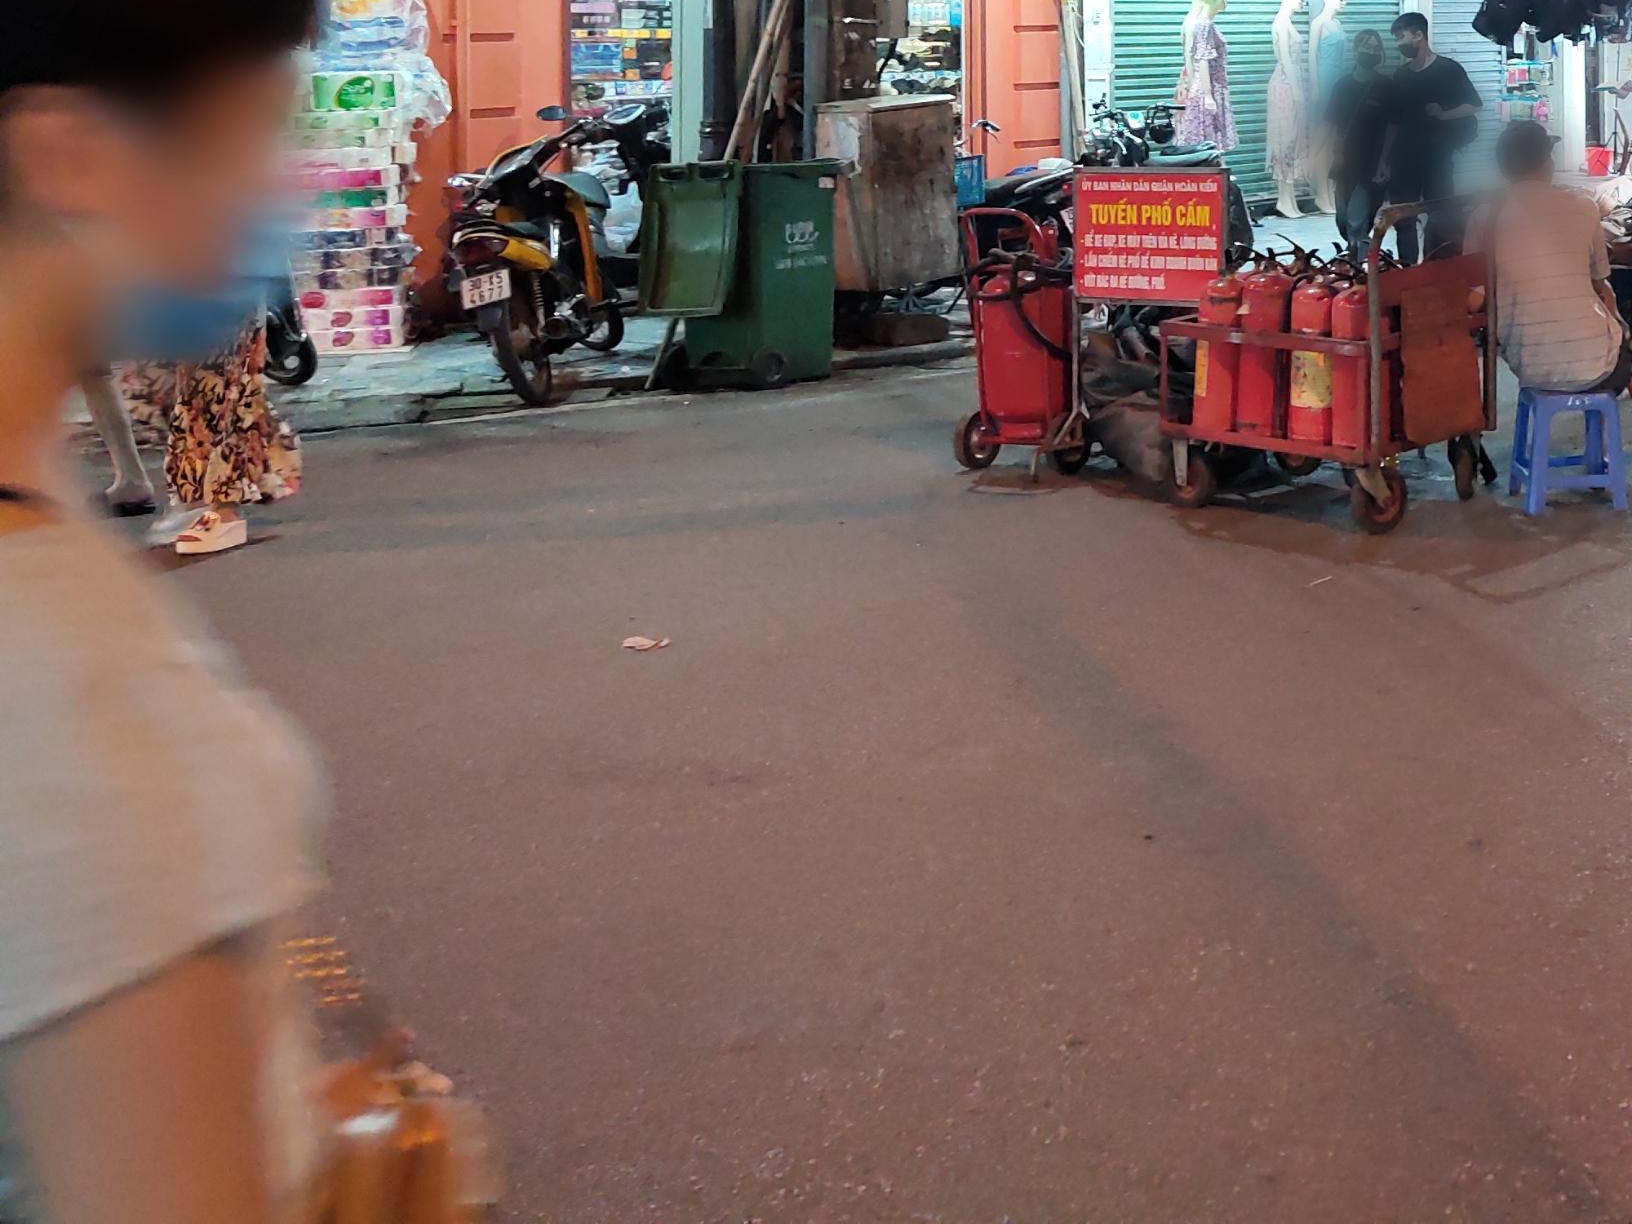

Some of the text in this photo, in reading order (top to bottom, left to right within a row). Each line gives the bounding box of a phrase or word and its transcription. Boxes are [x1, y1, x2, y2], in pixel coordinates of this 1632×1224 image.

[1090, 198, 1211, 227] TUYẾN PHỐ CẤM
